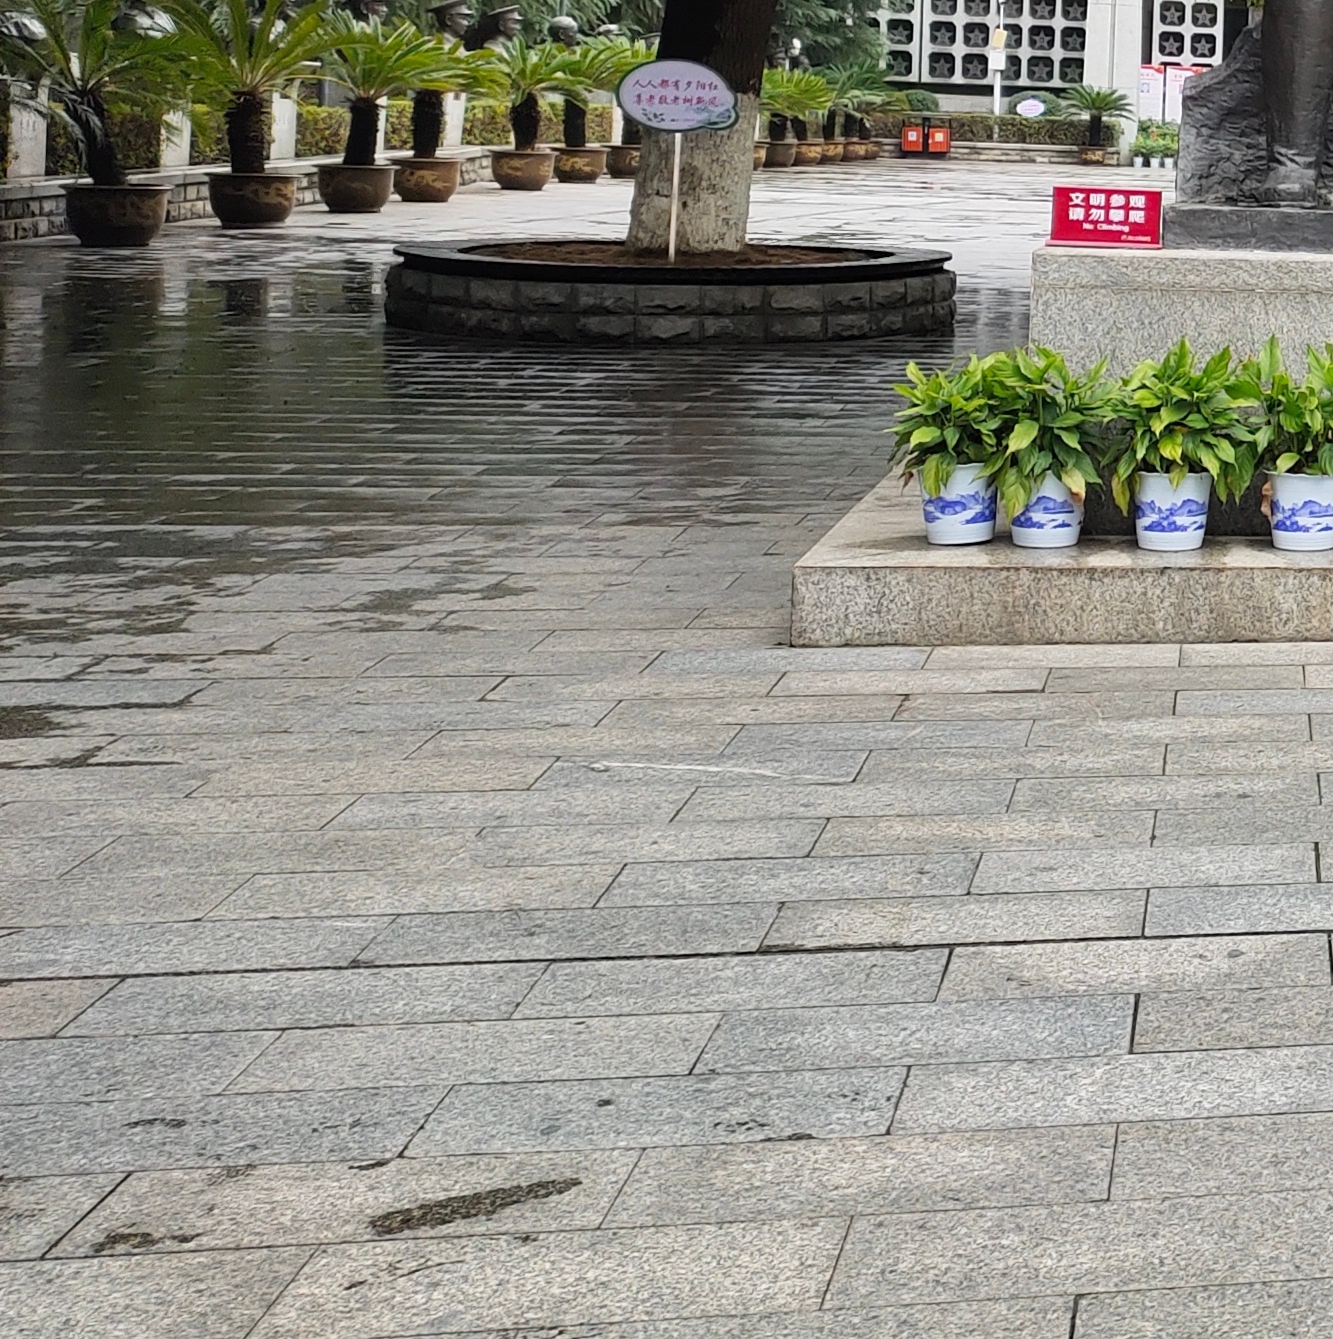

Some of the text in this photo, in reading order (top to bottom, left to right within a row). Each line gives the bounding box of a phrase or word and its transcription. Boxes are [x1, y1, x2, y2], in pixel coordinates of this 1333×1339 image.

[1068, 193, 1146, 209] 文明参观
[1068, 207, 1146, 224] 请勿攀爬
[1082, 222, 1130, 233] No Climbing
